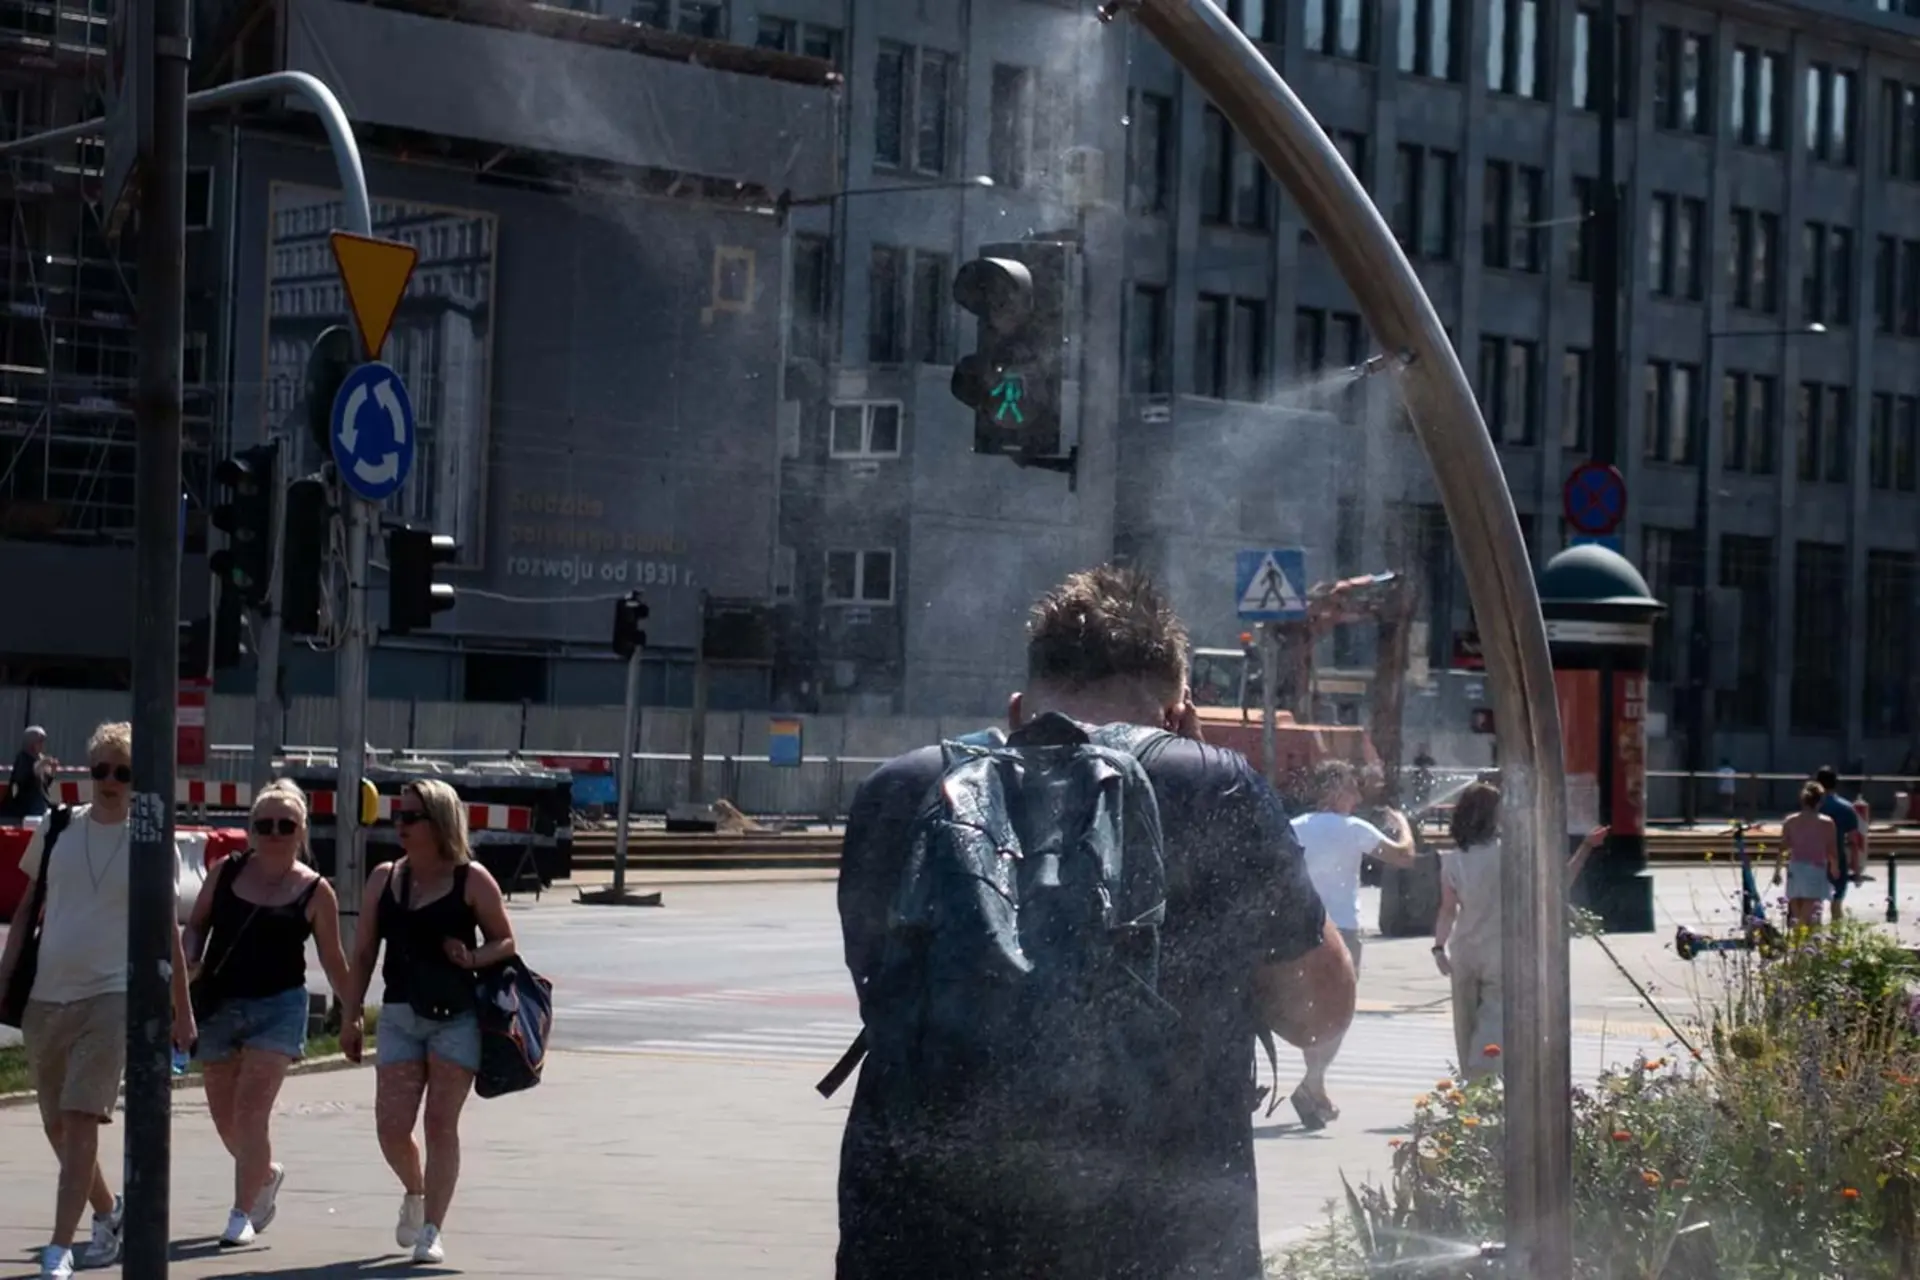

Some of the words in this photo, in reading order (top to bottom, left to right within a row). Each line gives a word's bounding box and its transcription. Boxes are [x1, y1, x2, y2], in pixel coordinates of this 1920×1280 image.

[507, 554, 594, 585] rozwoju
[601, 560, 627, 582] od
[636, 560, 677, 586] 1931
